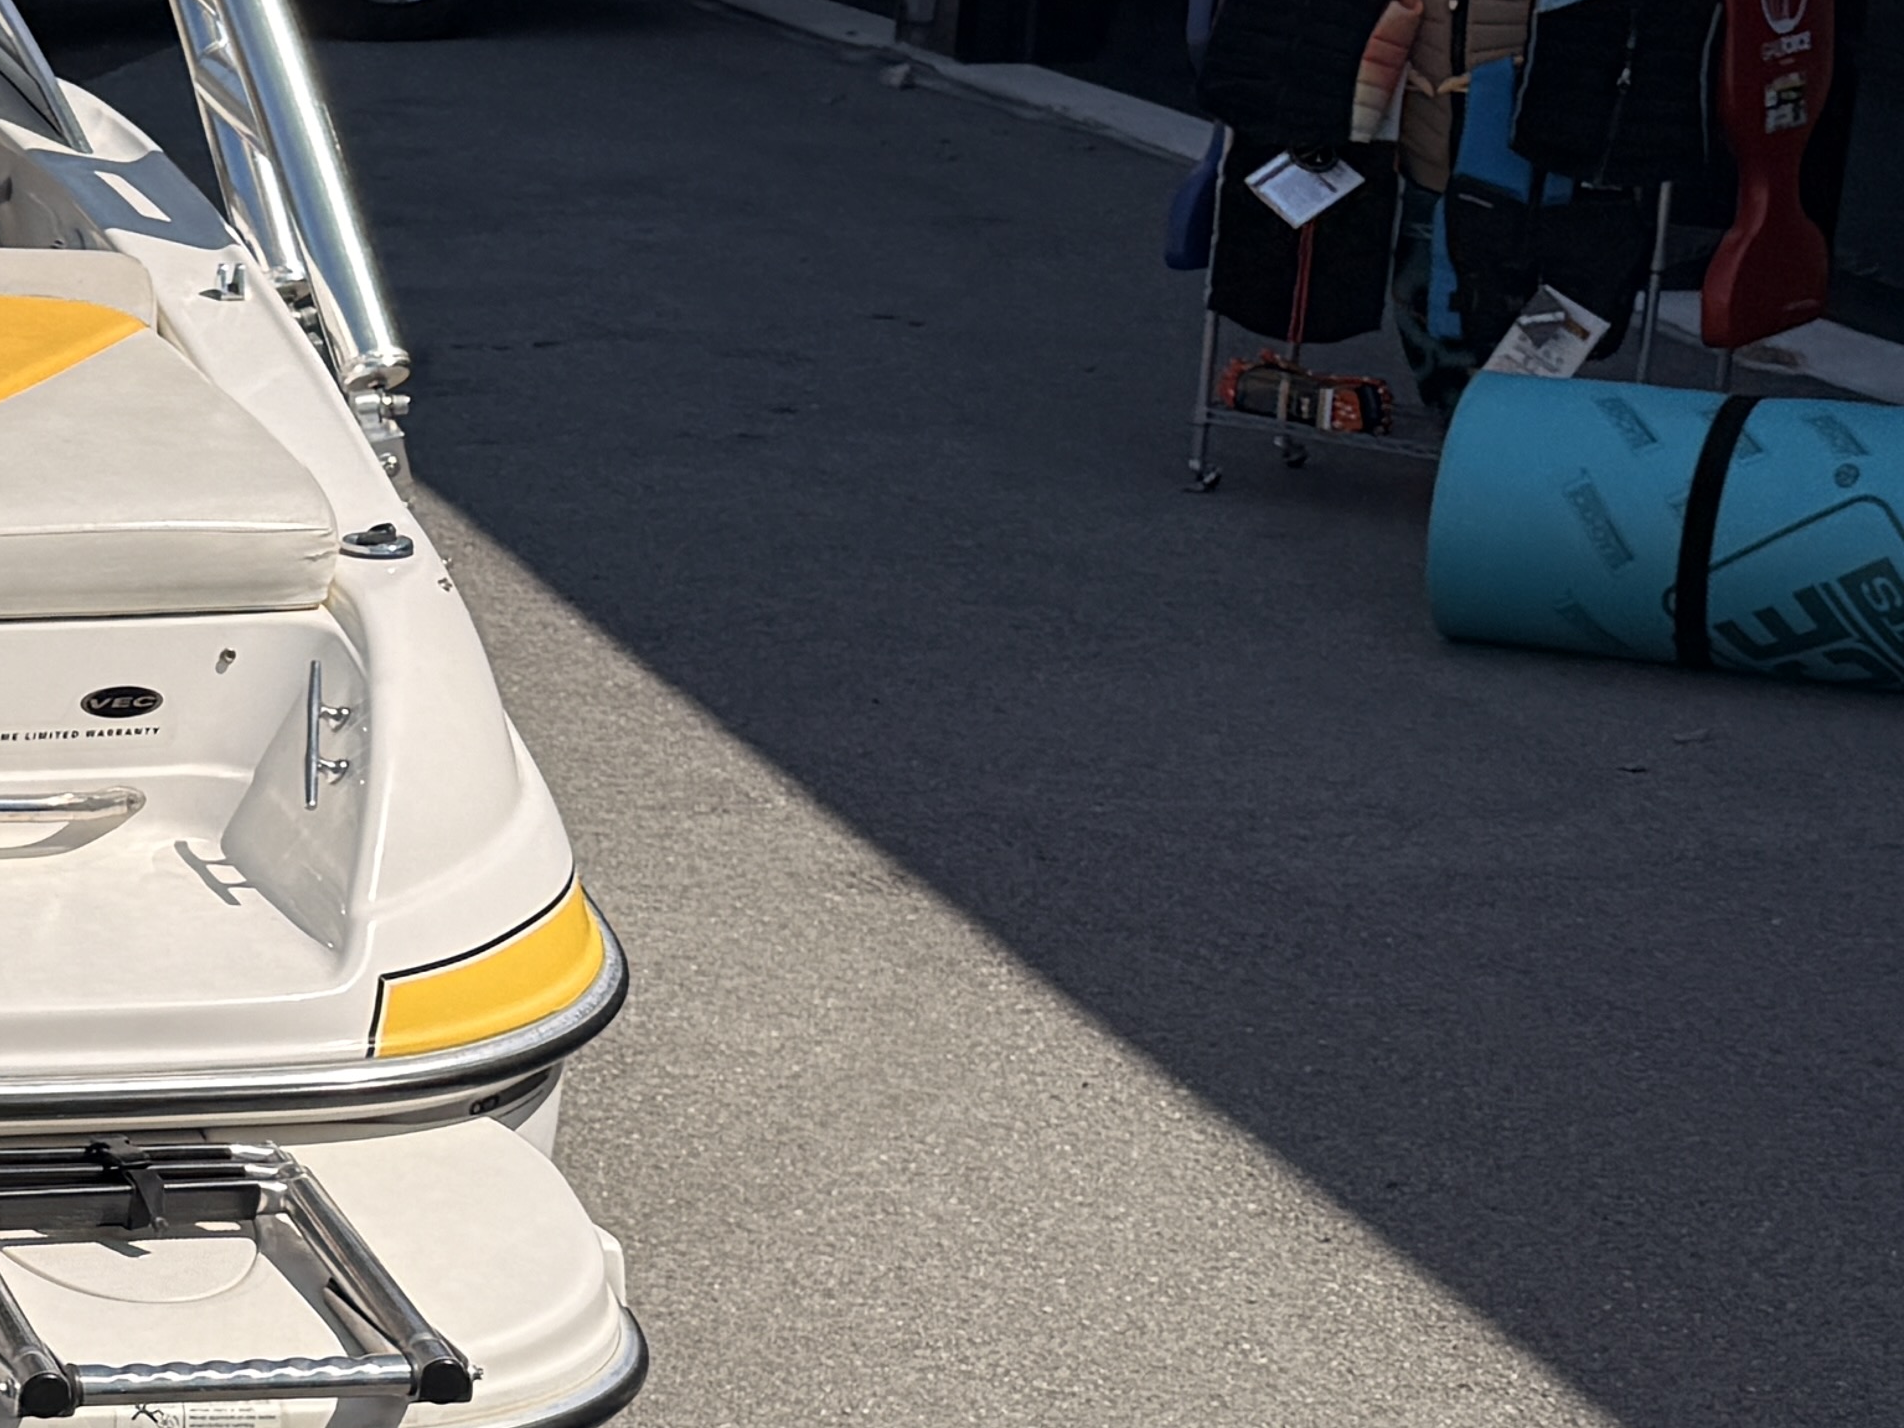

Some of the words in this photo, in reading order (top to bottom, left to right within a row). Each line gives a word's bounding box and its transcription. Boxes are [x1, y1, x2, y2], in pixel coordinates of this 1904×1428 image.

[89, 695, 156, 710] VEC
[24, 730, 80, 741] LIMITED
[85, 727, 161, 738] WARRANTY
